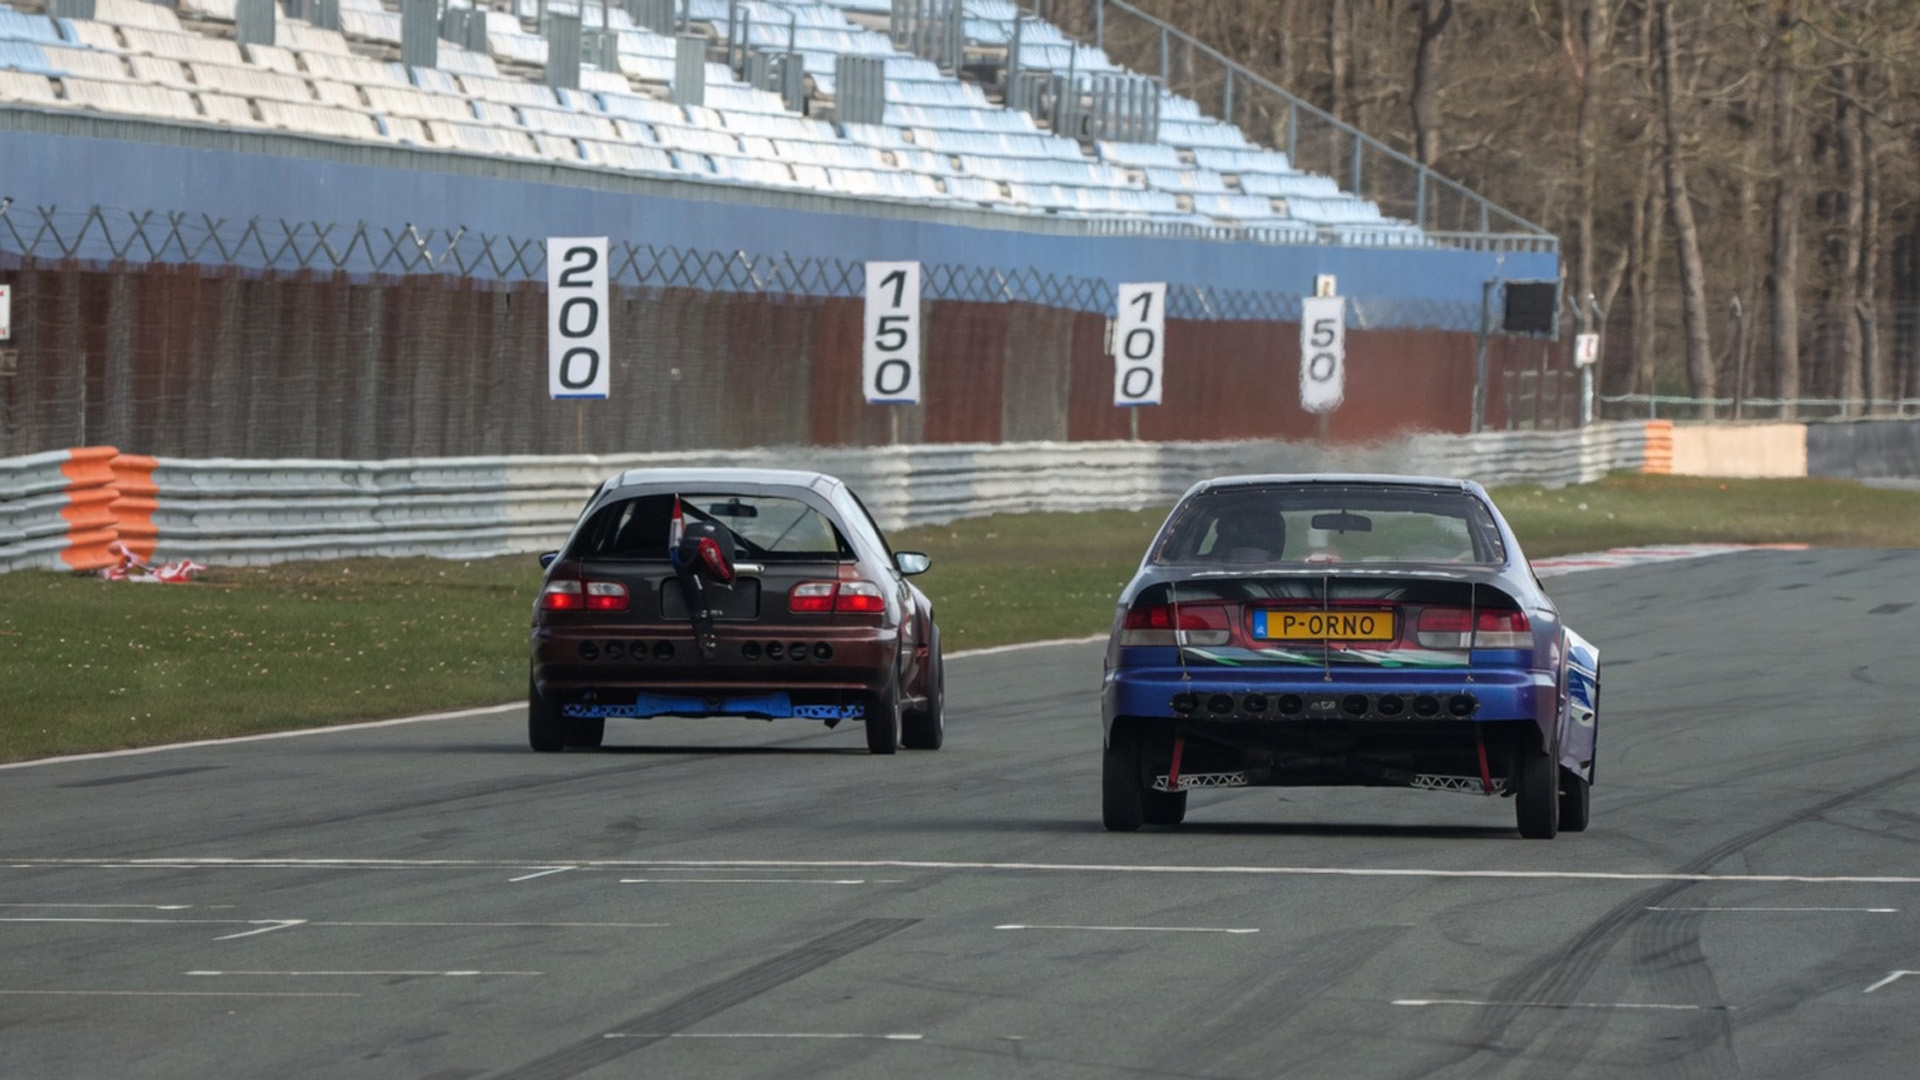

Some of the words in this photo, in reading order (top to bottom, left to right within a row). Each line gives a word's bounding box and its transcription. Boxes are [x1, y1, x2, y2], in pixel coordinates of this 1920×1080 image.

[558, 246, 599, 389] 200
[874, 270, 911, 395] 150
[1121, 292, 1155, 398] 100
[1310, 318, 1336, 381] 50
[1283, 615, 1375, 636] P-ORNO
